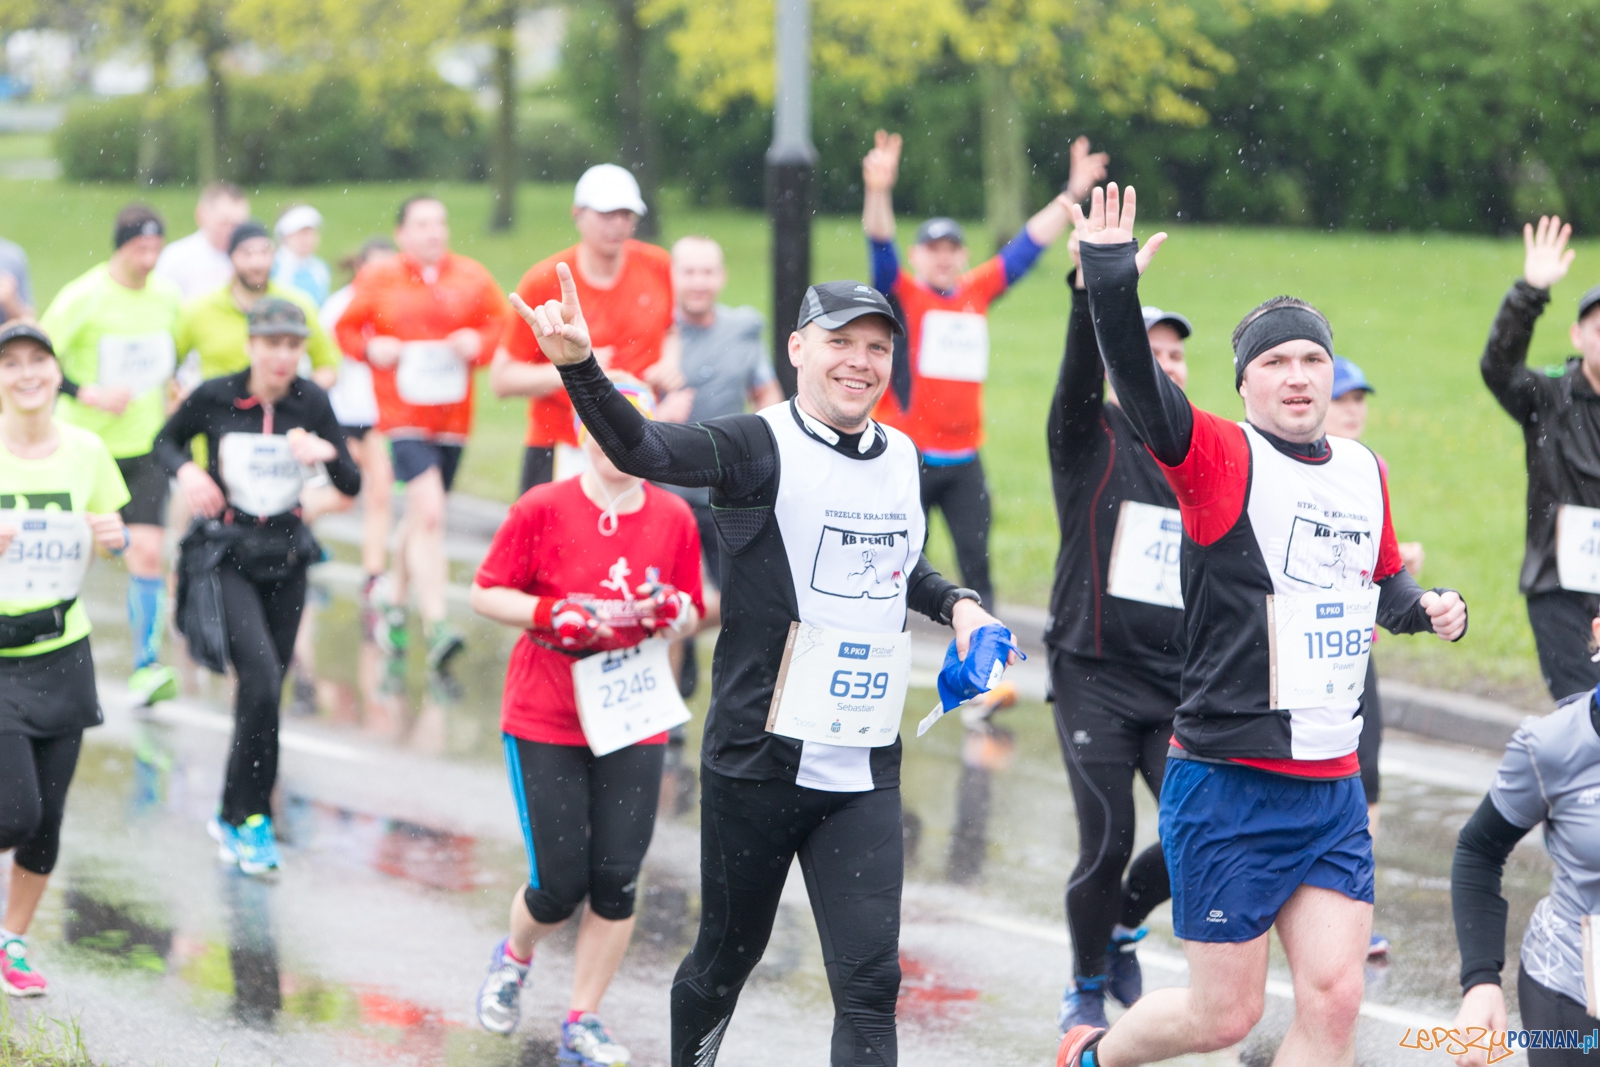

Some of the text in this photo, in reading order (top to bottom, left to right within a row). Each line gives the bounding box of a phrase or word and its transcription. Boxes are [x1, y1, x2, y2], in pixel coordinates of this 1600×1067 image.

[825, 509, 861, 520] STRZELCE
[842, 531, 894, 547] KB PENTO
[1304, 626, 1373, 660] 11983
[599, 667, 657, 709] 2246
[830, 670, 889, 699] 639
[836, 702, 875, 713] Sebastian
